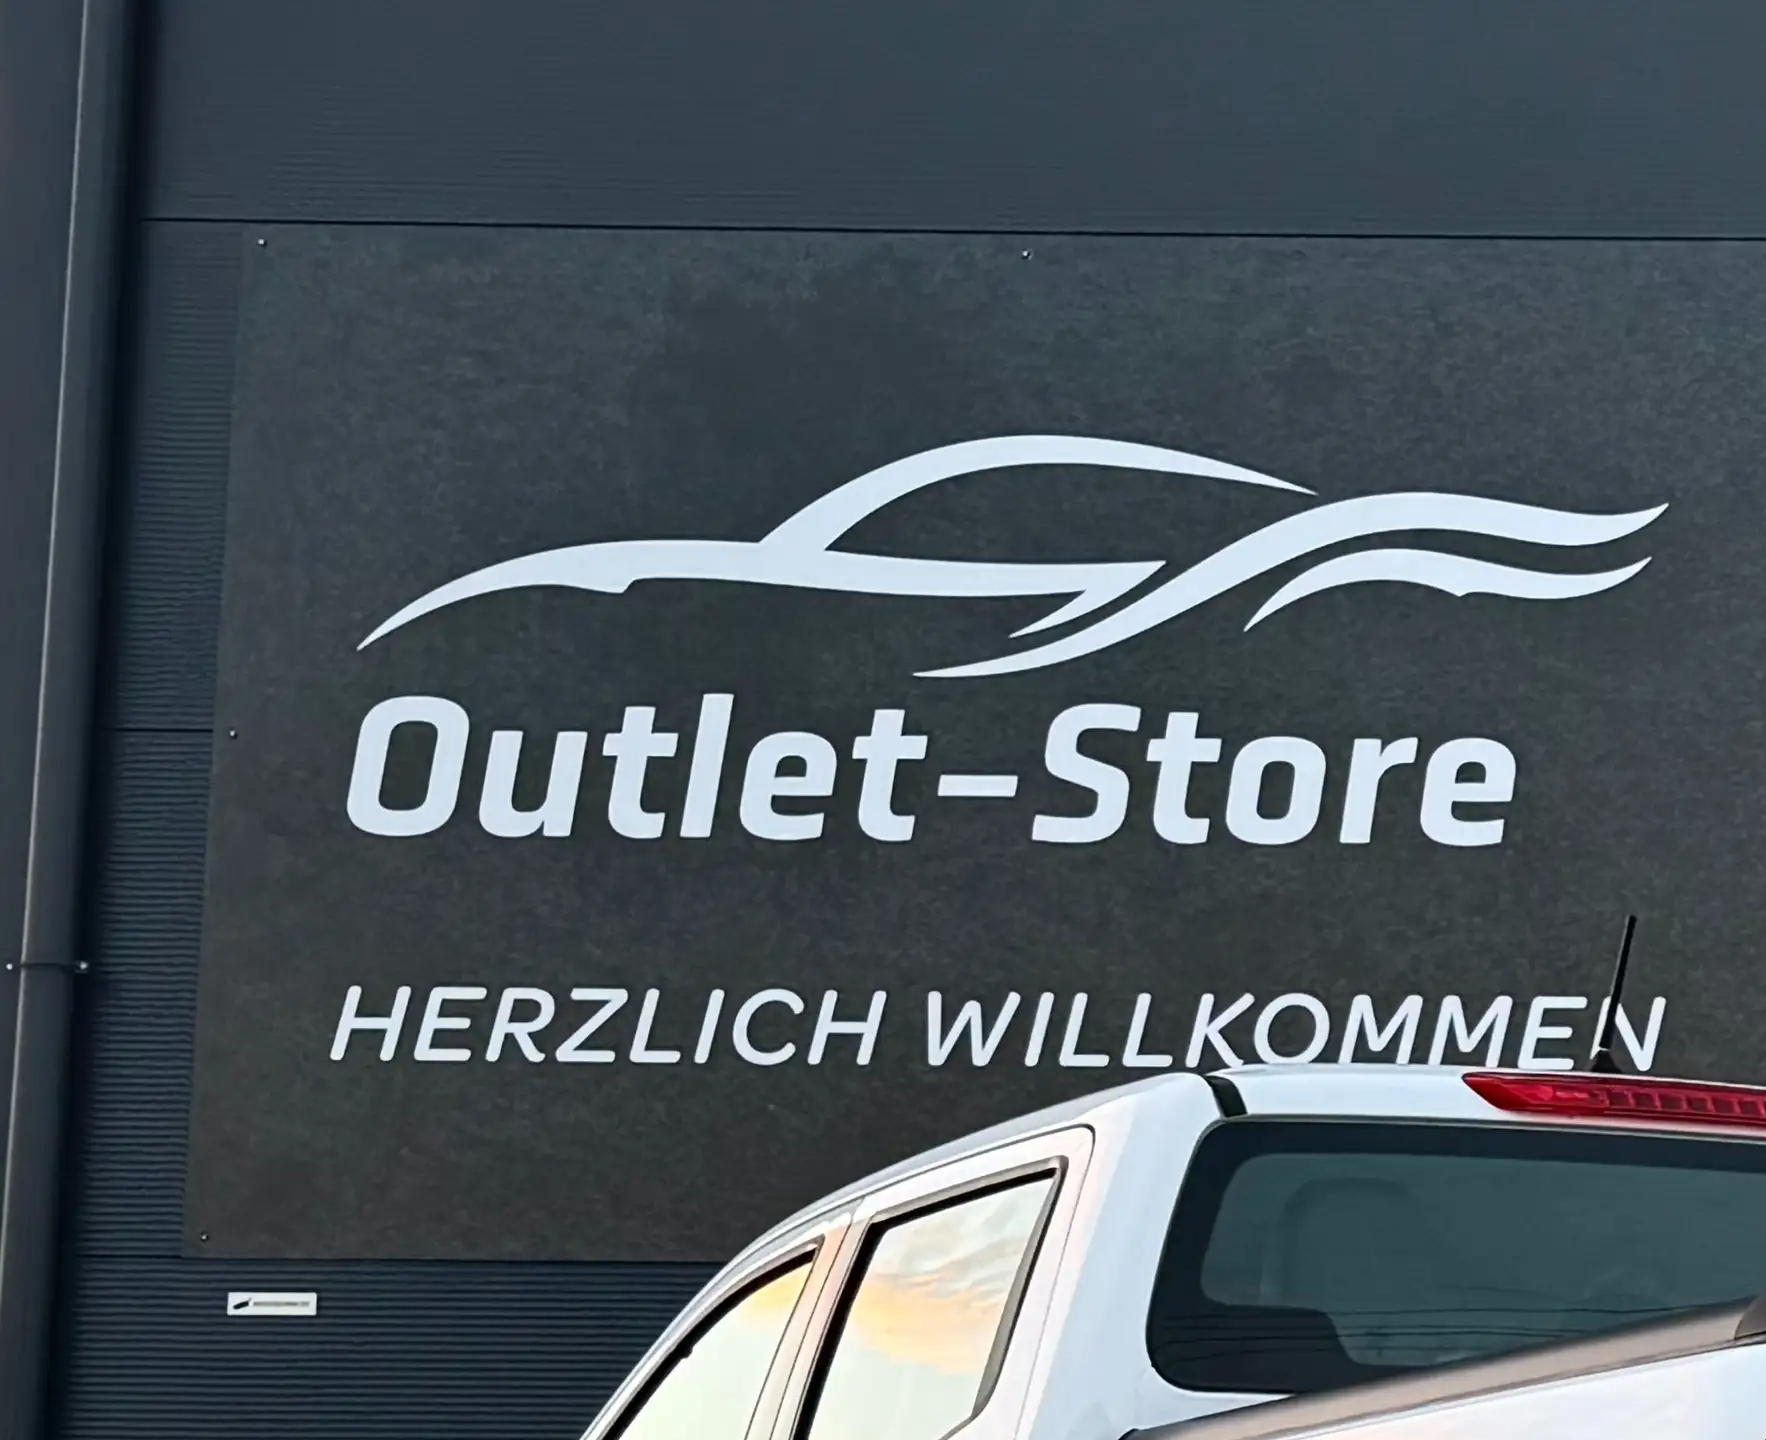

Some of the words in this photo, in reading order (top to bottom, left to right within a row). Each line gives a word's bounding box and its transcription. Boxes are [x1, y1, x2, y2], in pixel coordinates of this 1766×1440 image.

[346, 693, 1516, 847] Outlet-Store
[329, 985, 887, 1066] HERZLICH
[927, 990, 1667, 1072] WILLKOMMEN
